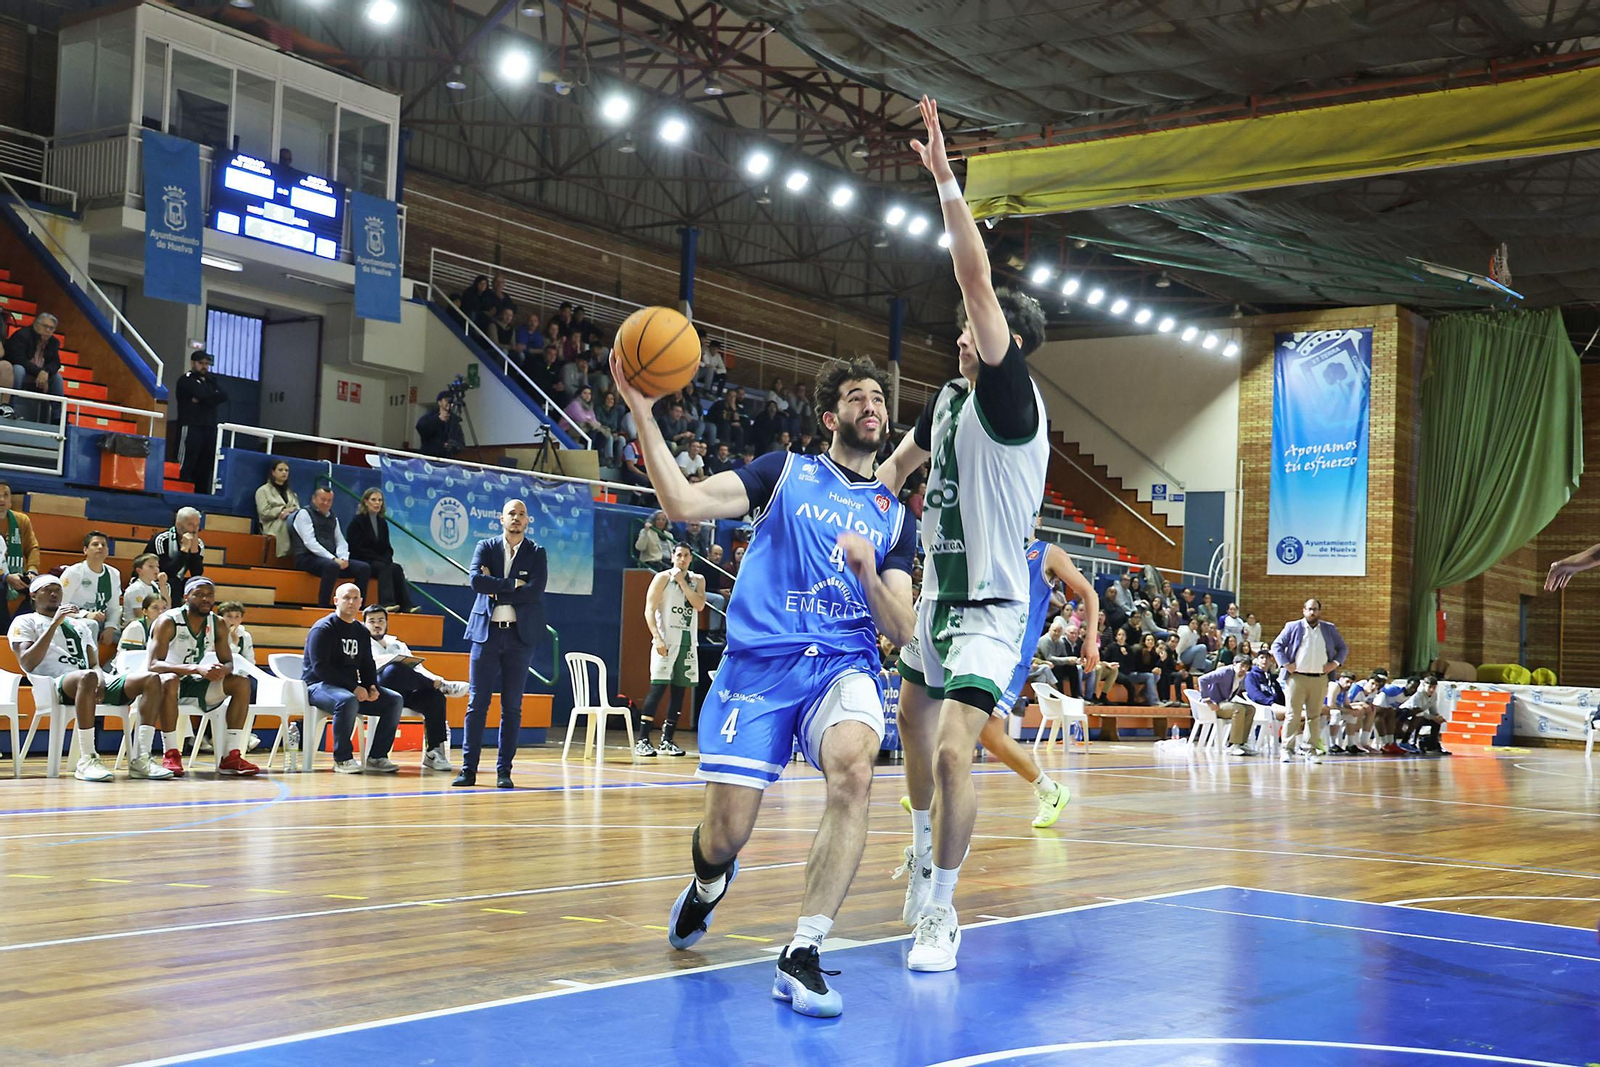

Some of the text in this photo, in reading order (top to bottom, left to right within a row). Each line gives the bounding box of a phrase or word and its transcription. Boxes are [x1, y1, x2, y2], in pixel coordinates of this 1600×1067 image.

[150, 229, 199, 246] Ayuntamiento
[157, 240, 193, 254] de Huelva
[357, 255, 396, 269] Ayuntamiento
[371, 266, 392, 277] Huelva
[389, 394, 406, 406] 117
[1284, 440, 1358, 463] Apoyamos
[1285, 455, 1358, 477] tu esfuerzo
[828, 491, 863, 510] Huelva
[469, 506, 535, 523] Ayuntao
[488, 520, 499, 531] de
[829, 542, 845, 572] 4
[720, 707, 740, 744] 4
